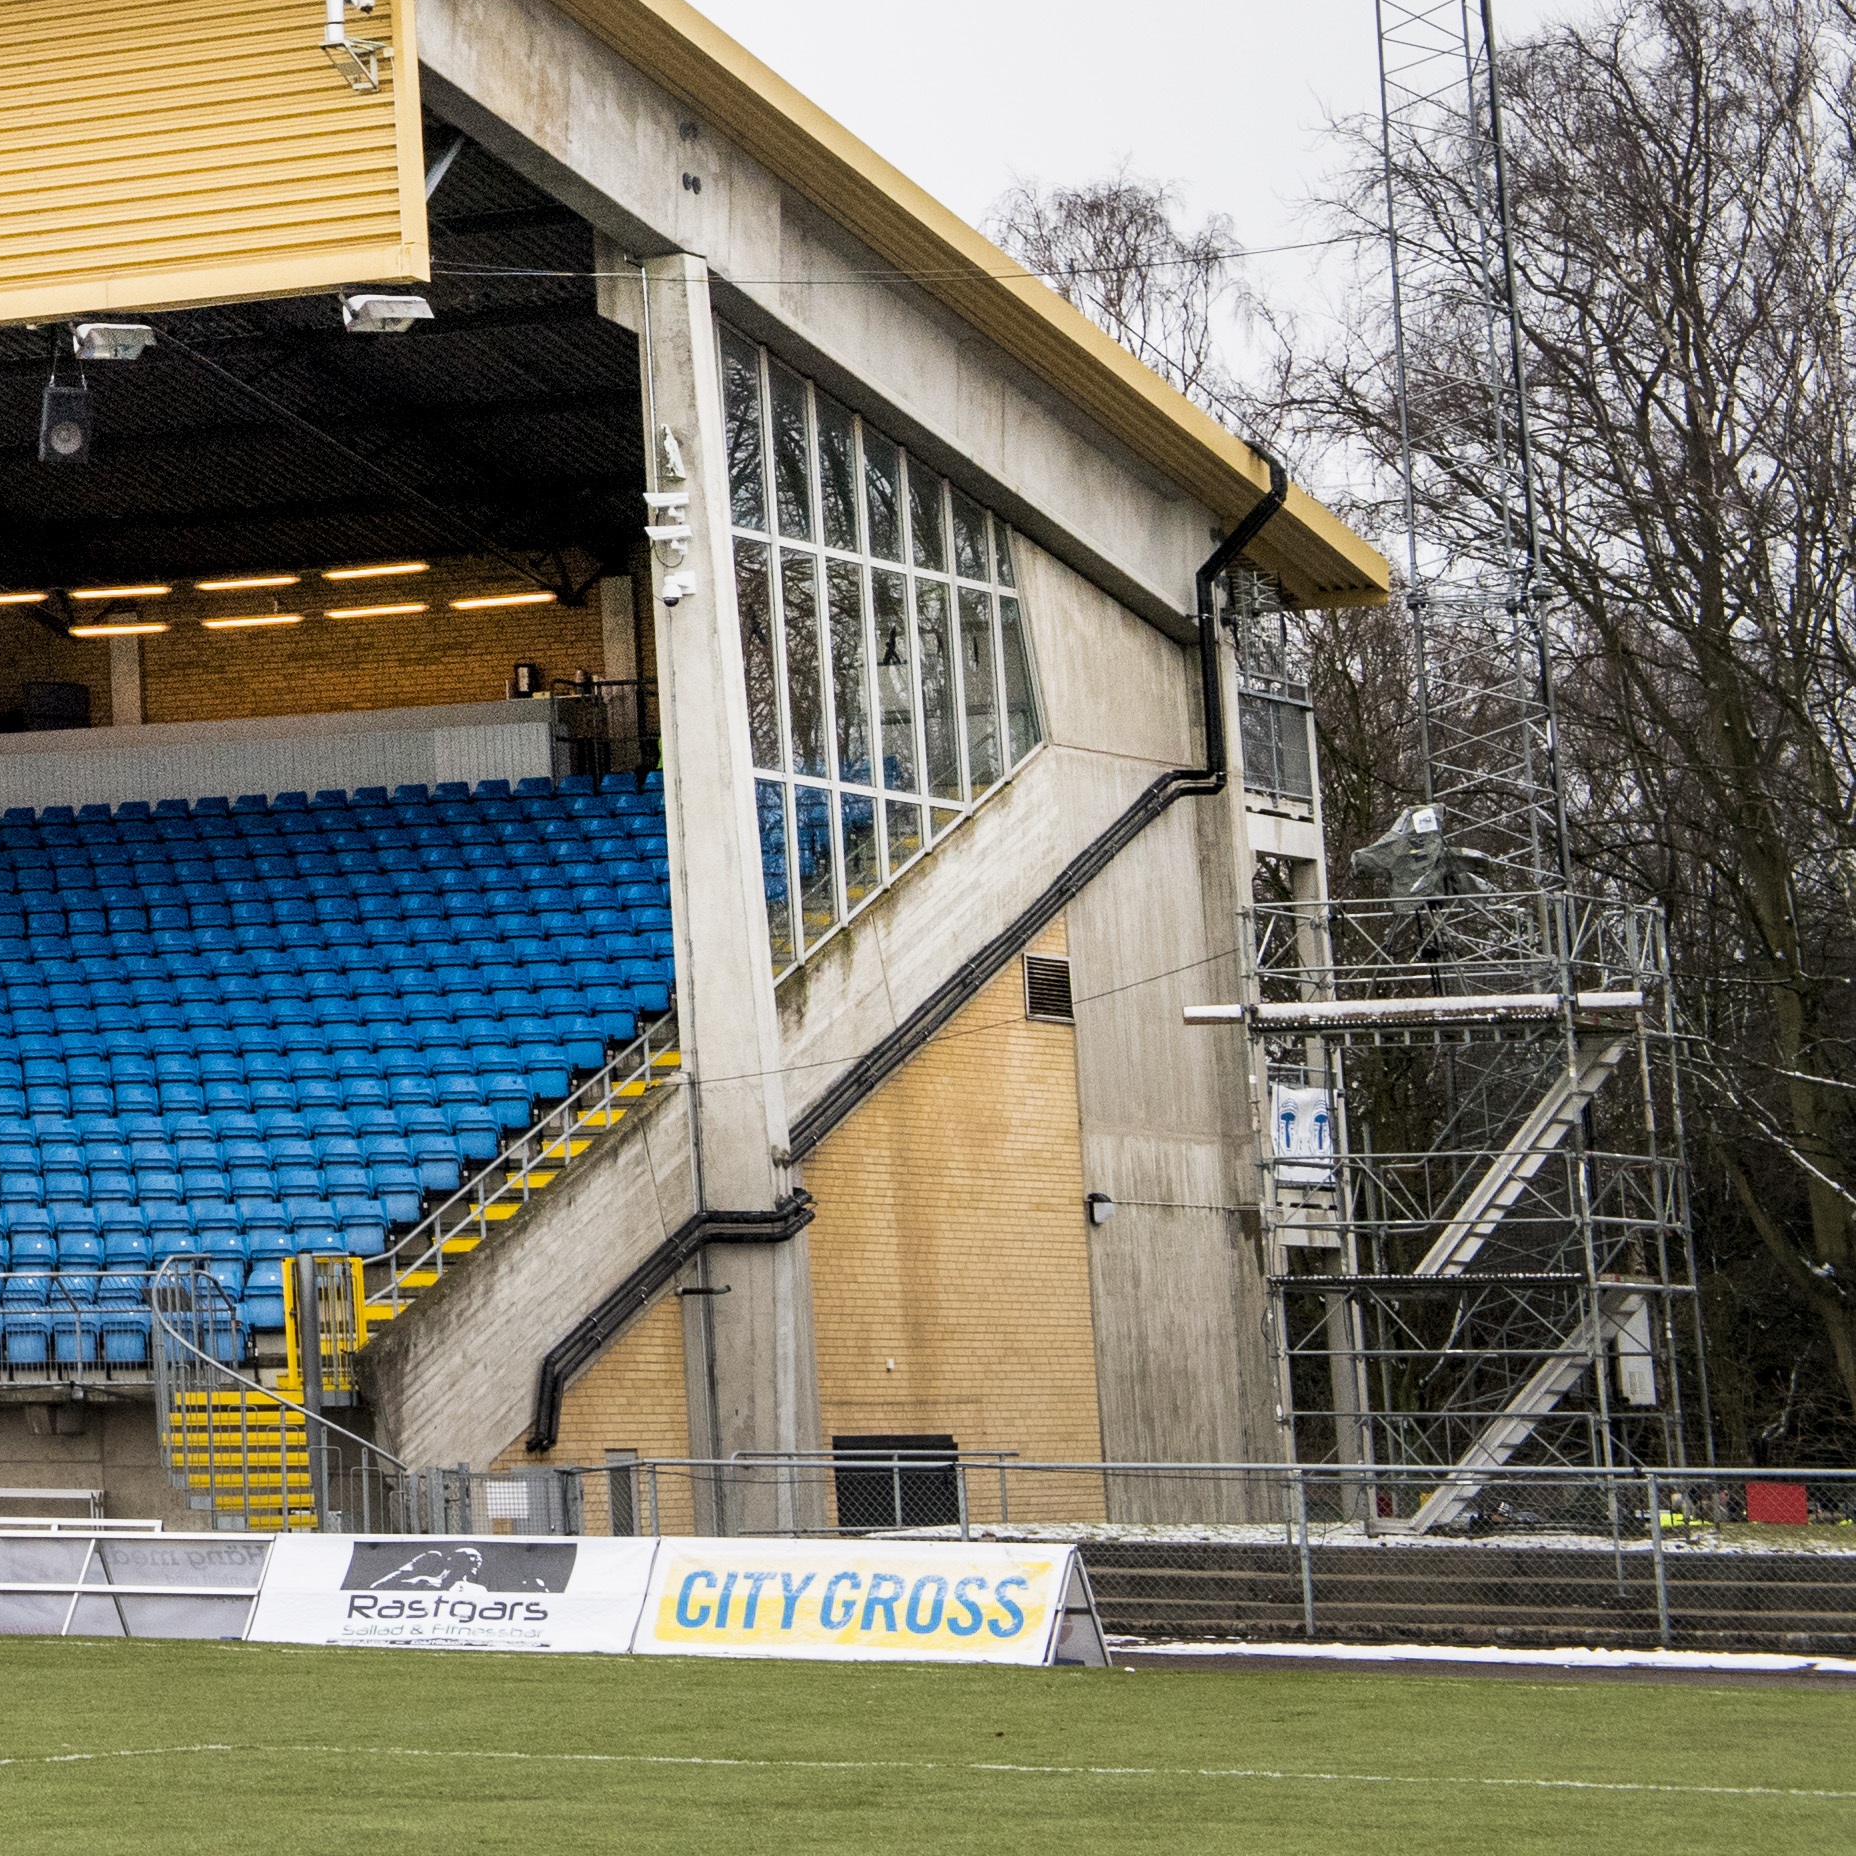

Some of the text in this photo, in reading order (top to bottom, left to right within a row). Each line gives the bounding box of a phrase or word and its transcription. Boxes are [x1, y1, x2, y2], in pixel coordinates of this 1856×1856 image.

[347, 1594, 549, 1623] Rastgars
[675, 1569, 1029, 1638] CITY GROSS
[341, 1623, 544, 1638] Sallad & Fitnessbar
